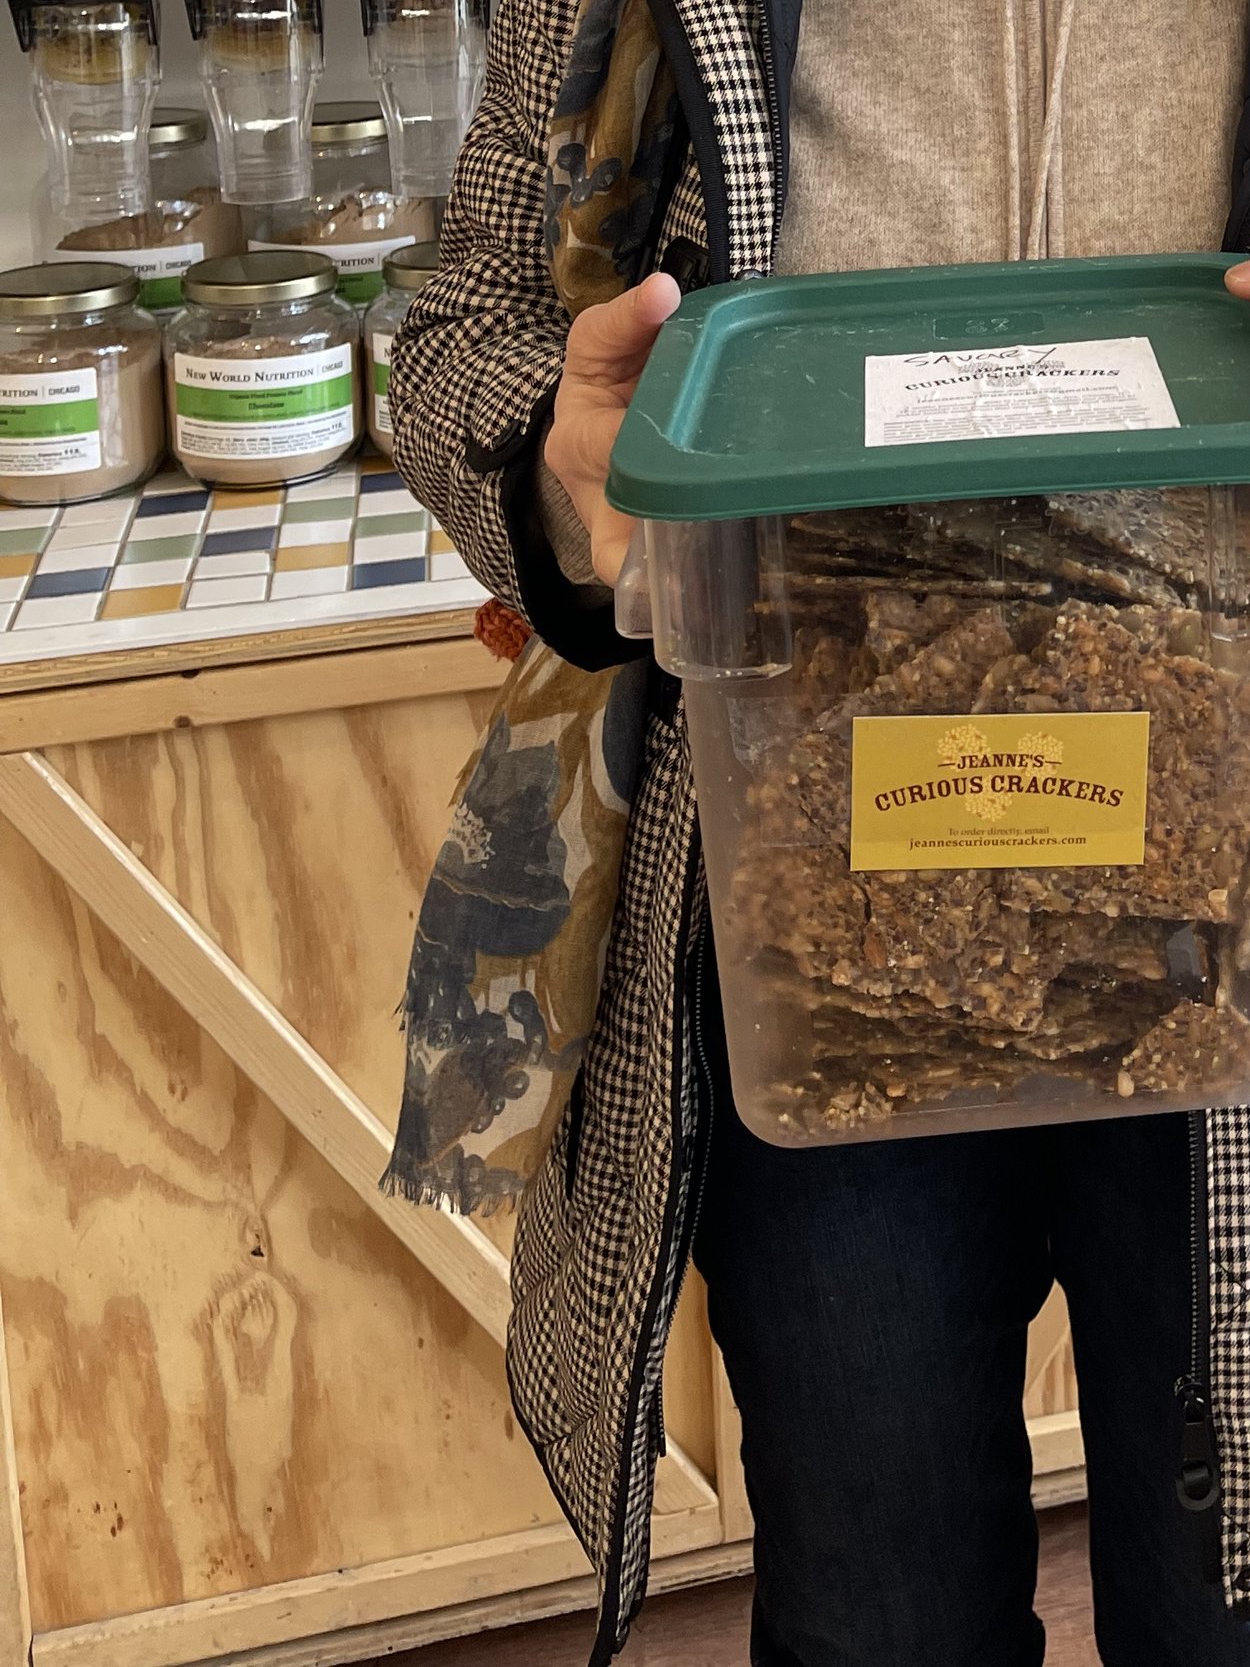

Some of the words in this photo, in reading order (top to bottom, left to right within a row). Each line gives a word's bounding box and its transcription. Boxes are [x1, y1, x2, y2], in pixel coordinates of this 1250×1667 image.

[185, 367, 207, 381] NEW
[209, 370, 251, 383] WORLD
[254, 367, 314, 383] NUTRITION
[904, 370, 999, 391] CURIOUS
[1005, 368, 1121, 382] CRACKERS
[957, 753, 1045, 769] JEANNE'S
[874, 775, 984, 812] CURIOUS
[990, 774, 1124, 808] CRACKERS
[909, 835, 1087, 851] jeannescuriouscrackers.com
